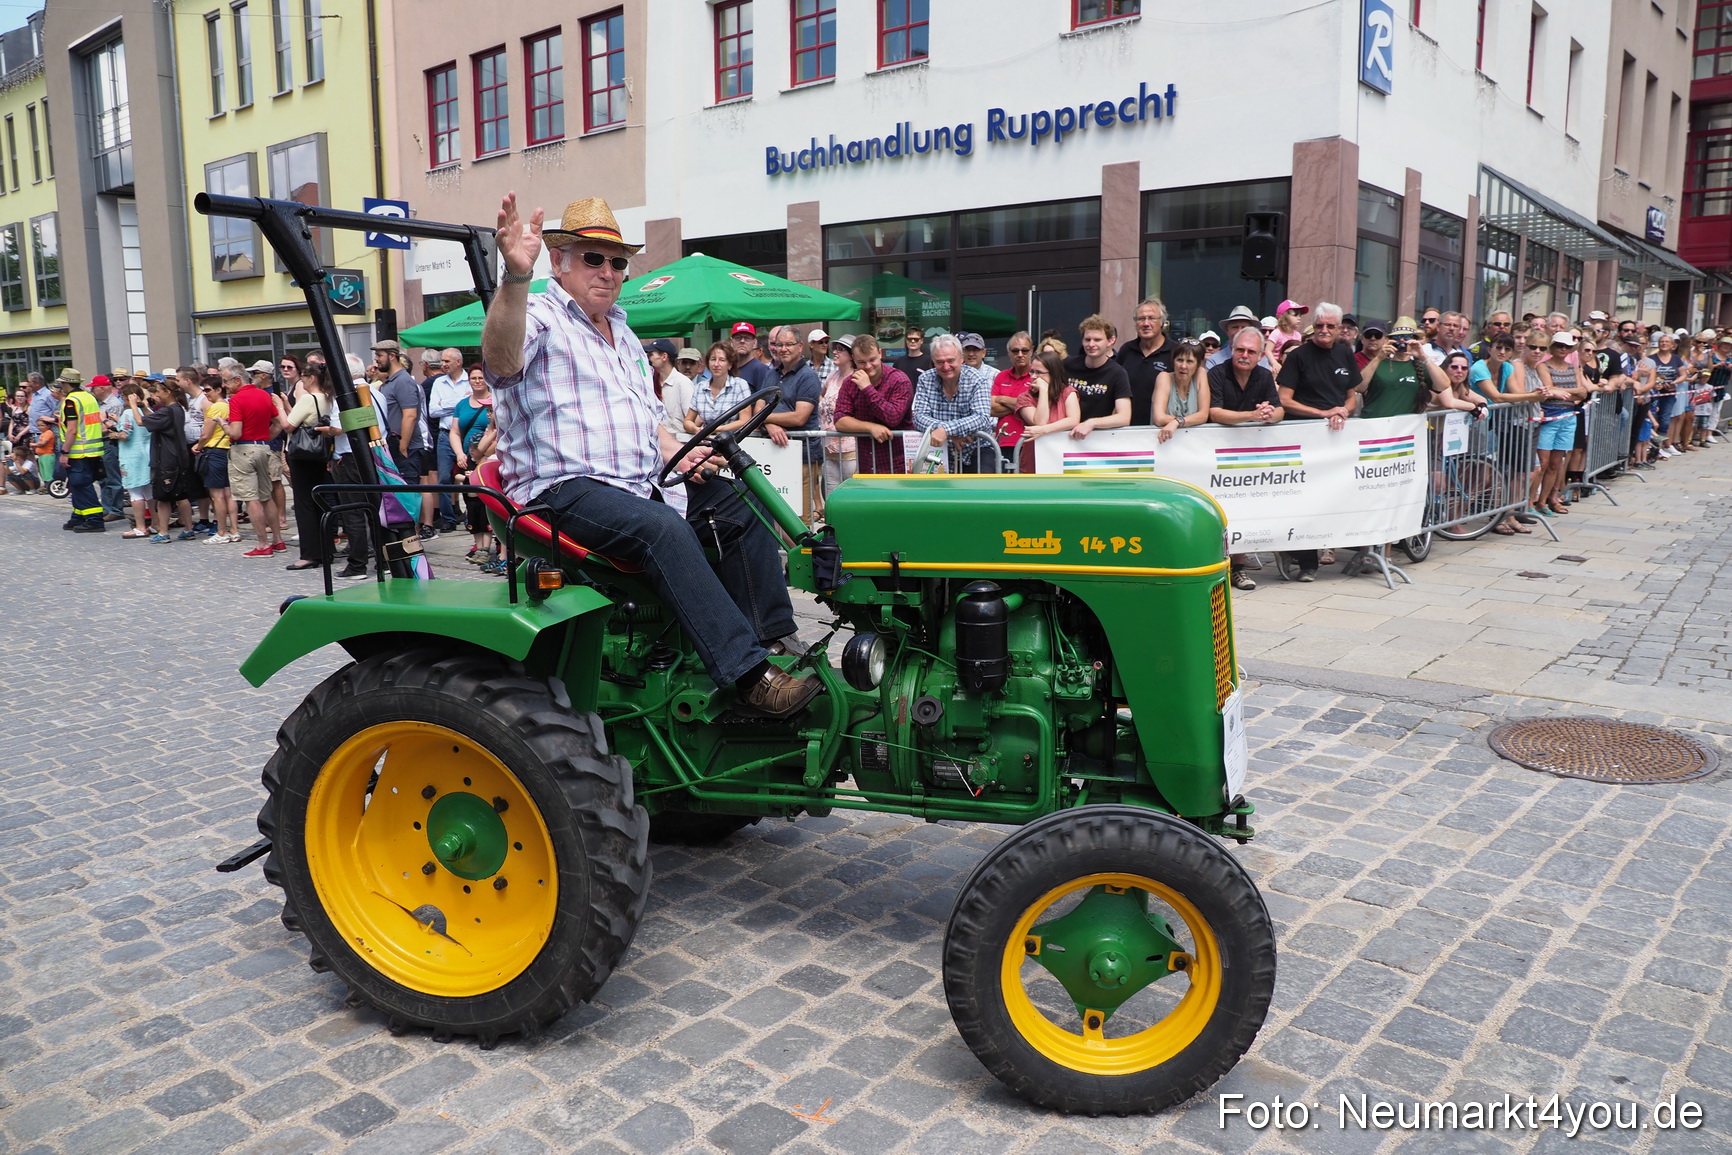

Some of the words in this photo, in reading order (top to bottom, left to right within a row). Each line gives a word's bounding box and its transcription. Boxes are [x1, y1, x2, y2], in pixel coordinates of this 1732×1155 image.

[766, 121, 975, 176] Buchhandlung
[987, 81, 1178, 146] Rupprecht
[415, 264, 431, 273] Unterer
[432, 261, 445, 270] Markt
[446, 259, 451, 268] 15
[338, 280, 354, 300] G2
[876, 307, 904, 316] OLDTIMER
[1210, 469, 1306, 488] NeuerMarkt
[1354, 459, 1416, 480] NeuerMarkt
[1214, 491, 1247, 500] einkaufen
[1250, 490, 1266, 498] leben
[1271, 489, 1302, 499] genießen
[1002, 530, 1062, 554] Bautz
